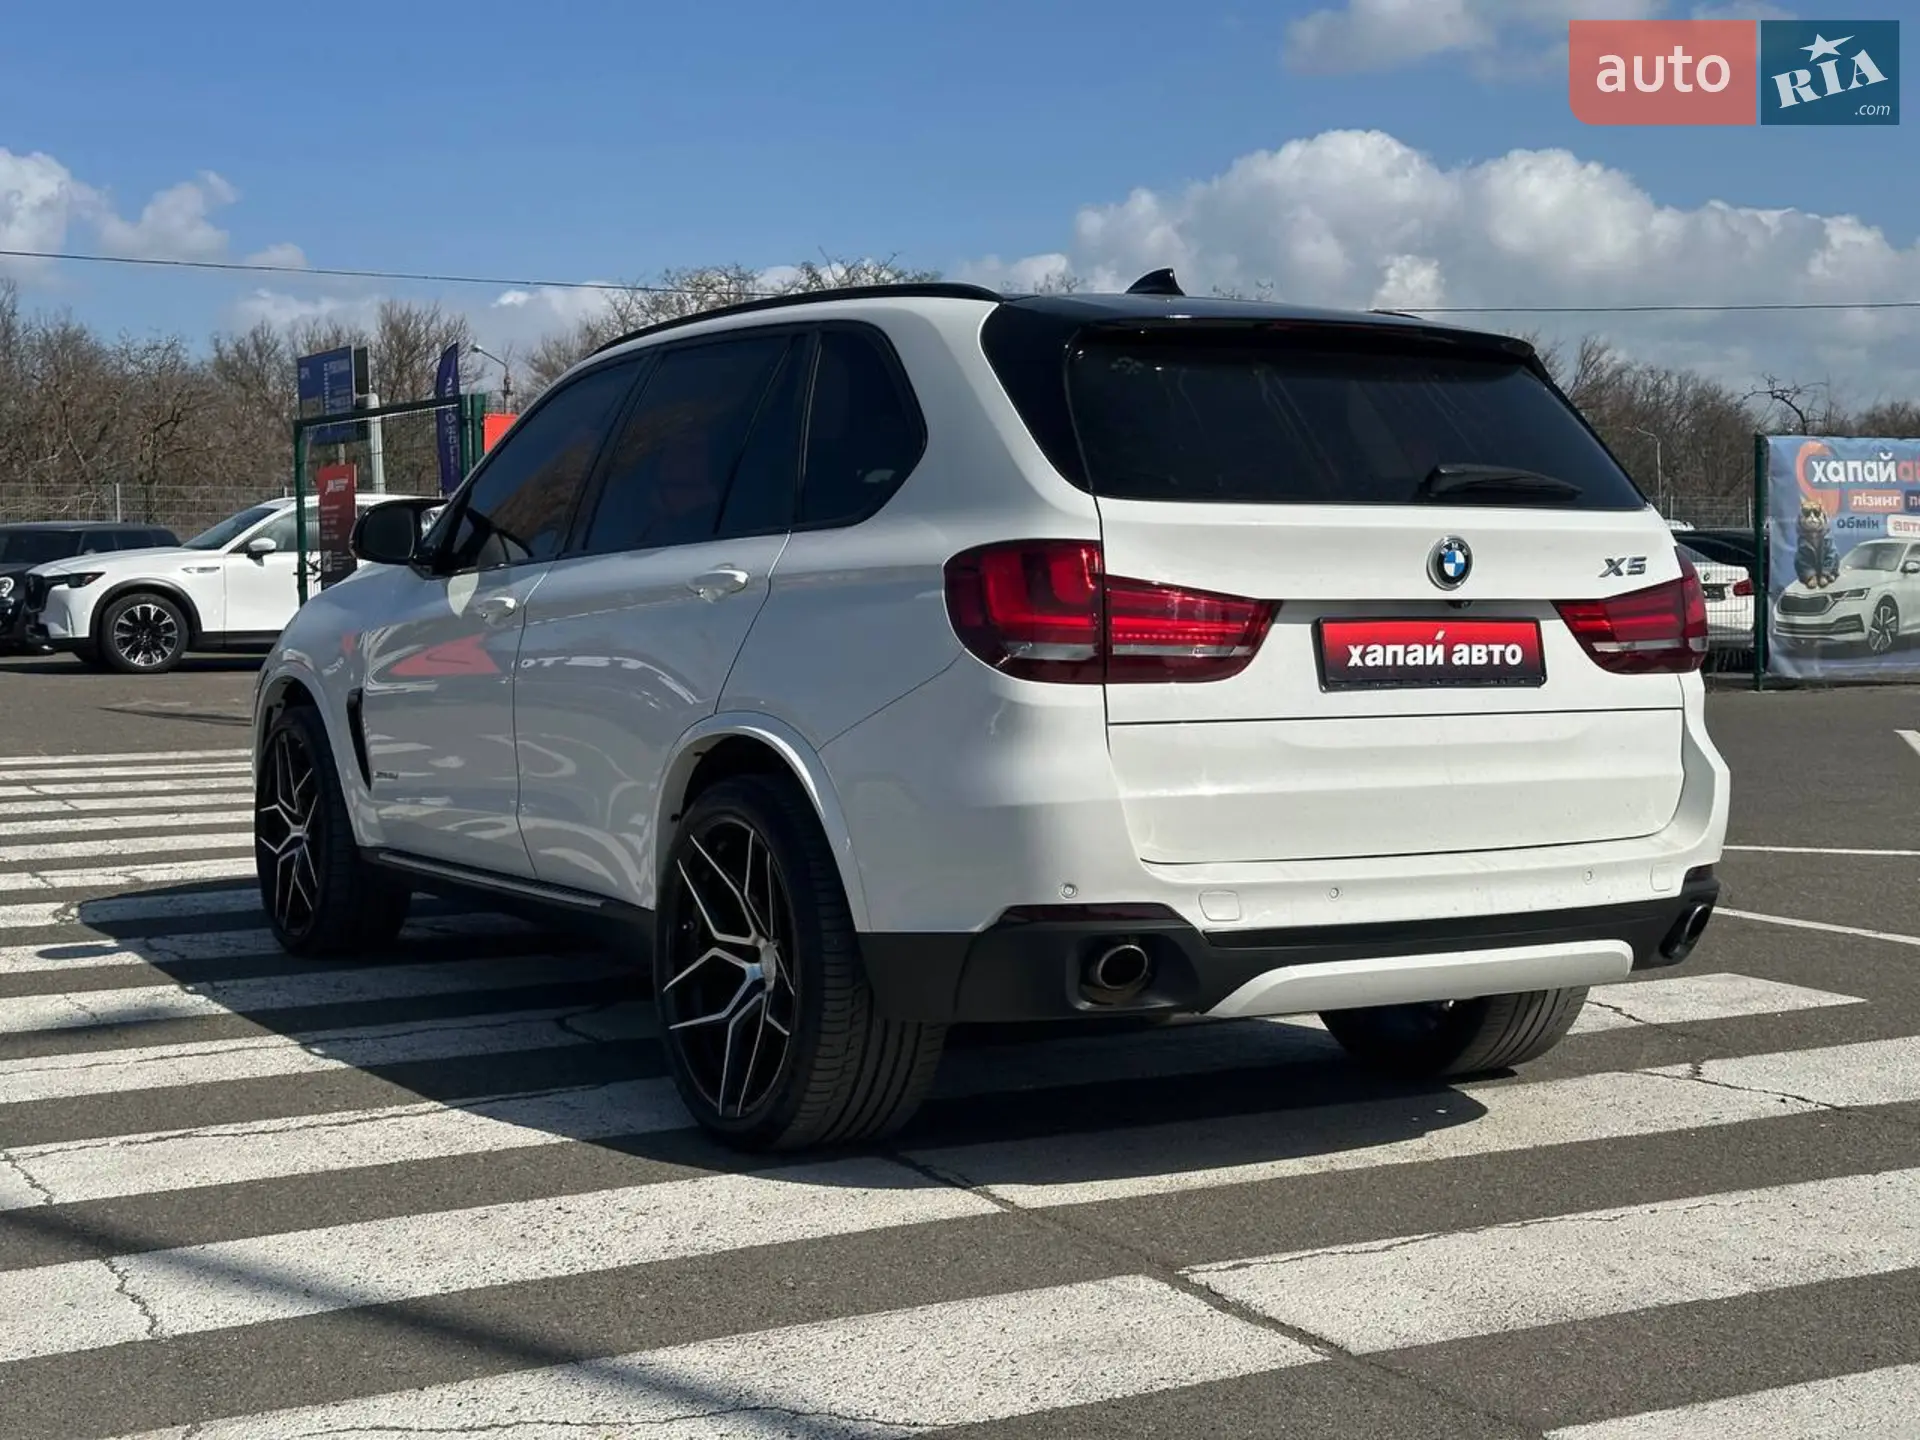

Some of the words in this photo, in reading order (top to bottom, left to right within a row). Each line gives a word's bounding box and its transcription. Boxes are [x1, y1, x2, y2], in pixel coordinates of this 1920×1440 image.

[1852, 492, 1901, 506] лізинг
[1837, 516, 1879, 529] обмін
[1599, 556, 1647, 578] X5
[1451, 643, 1523, 666] авто
